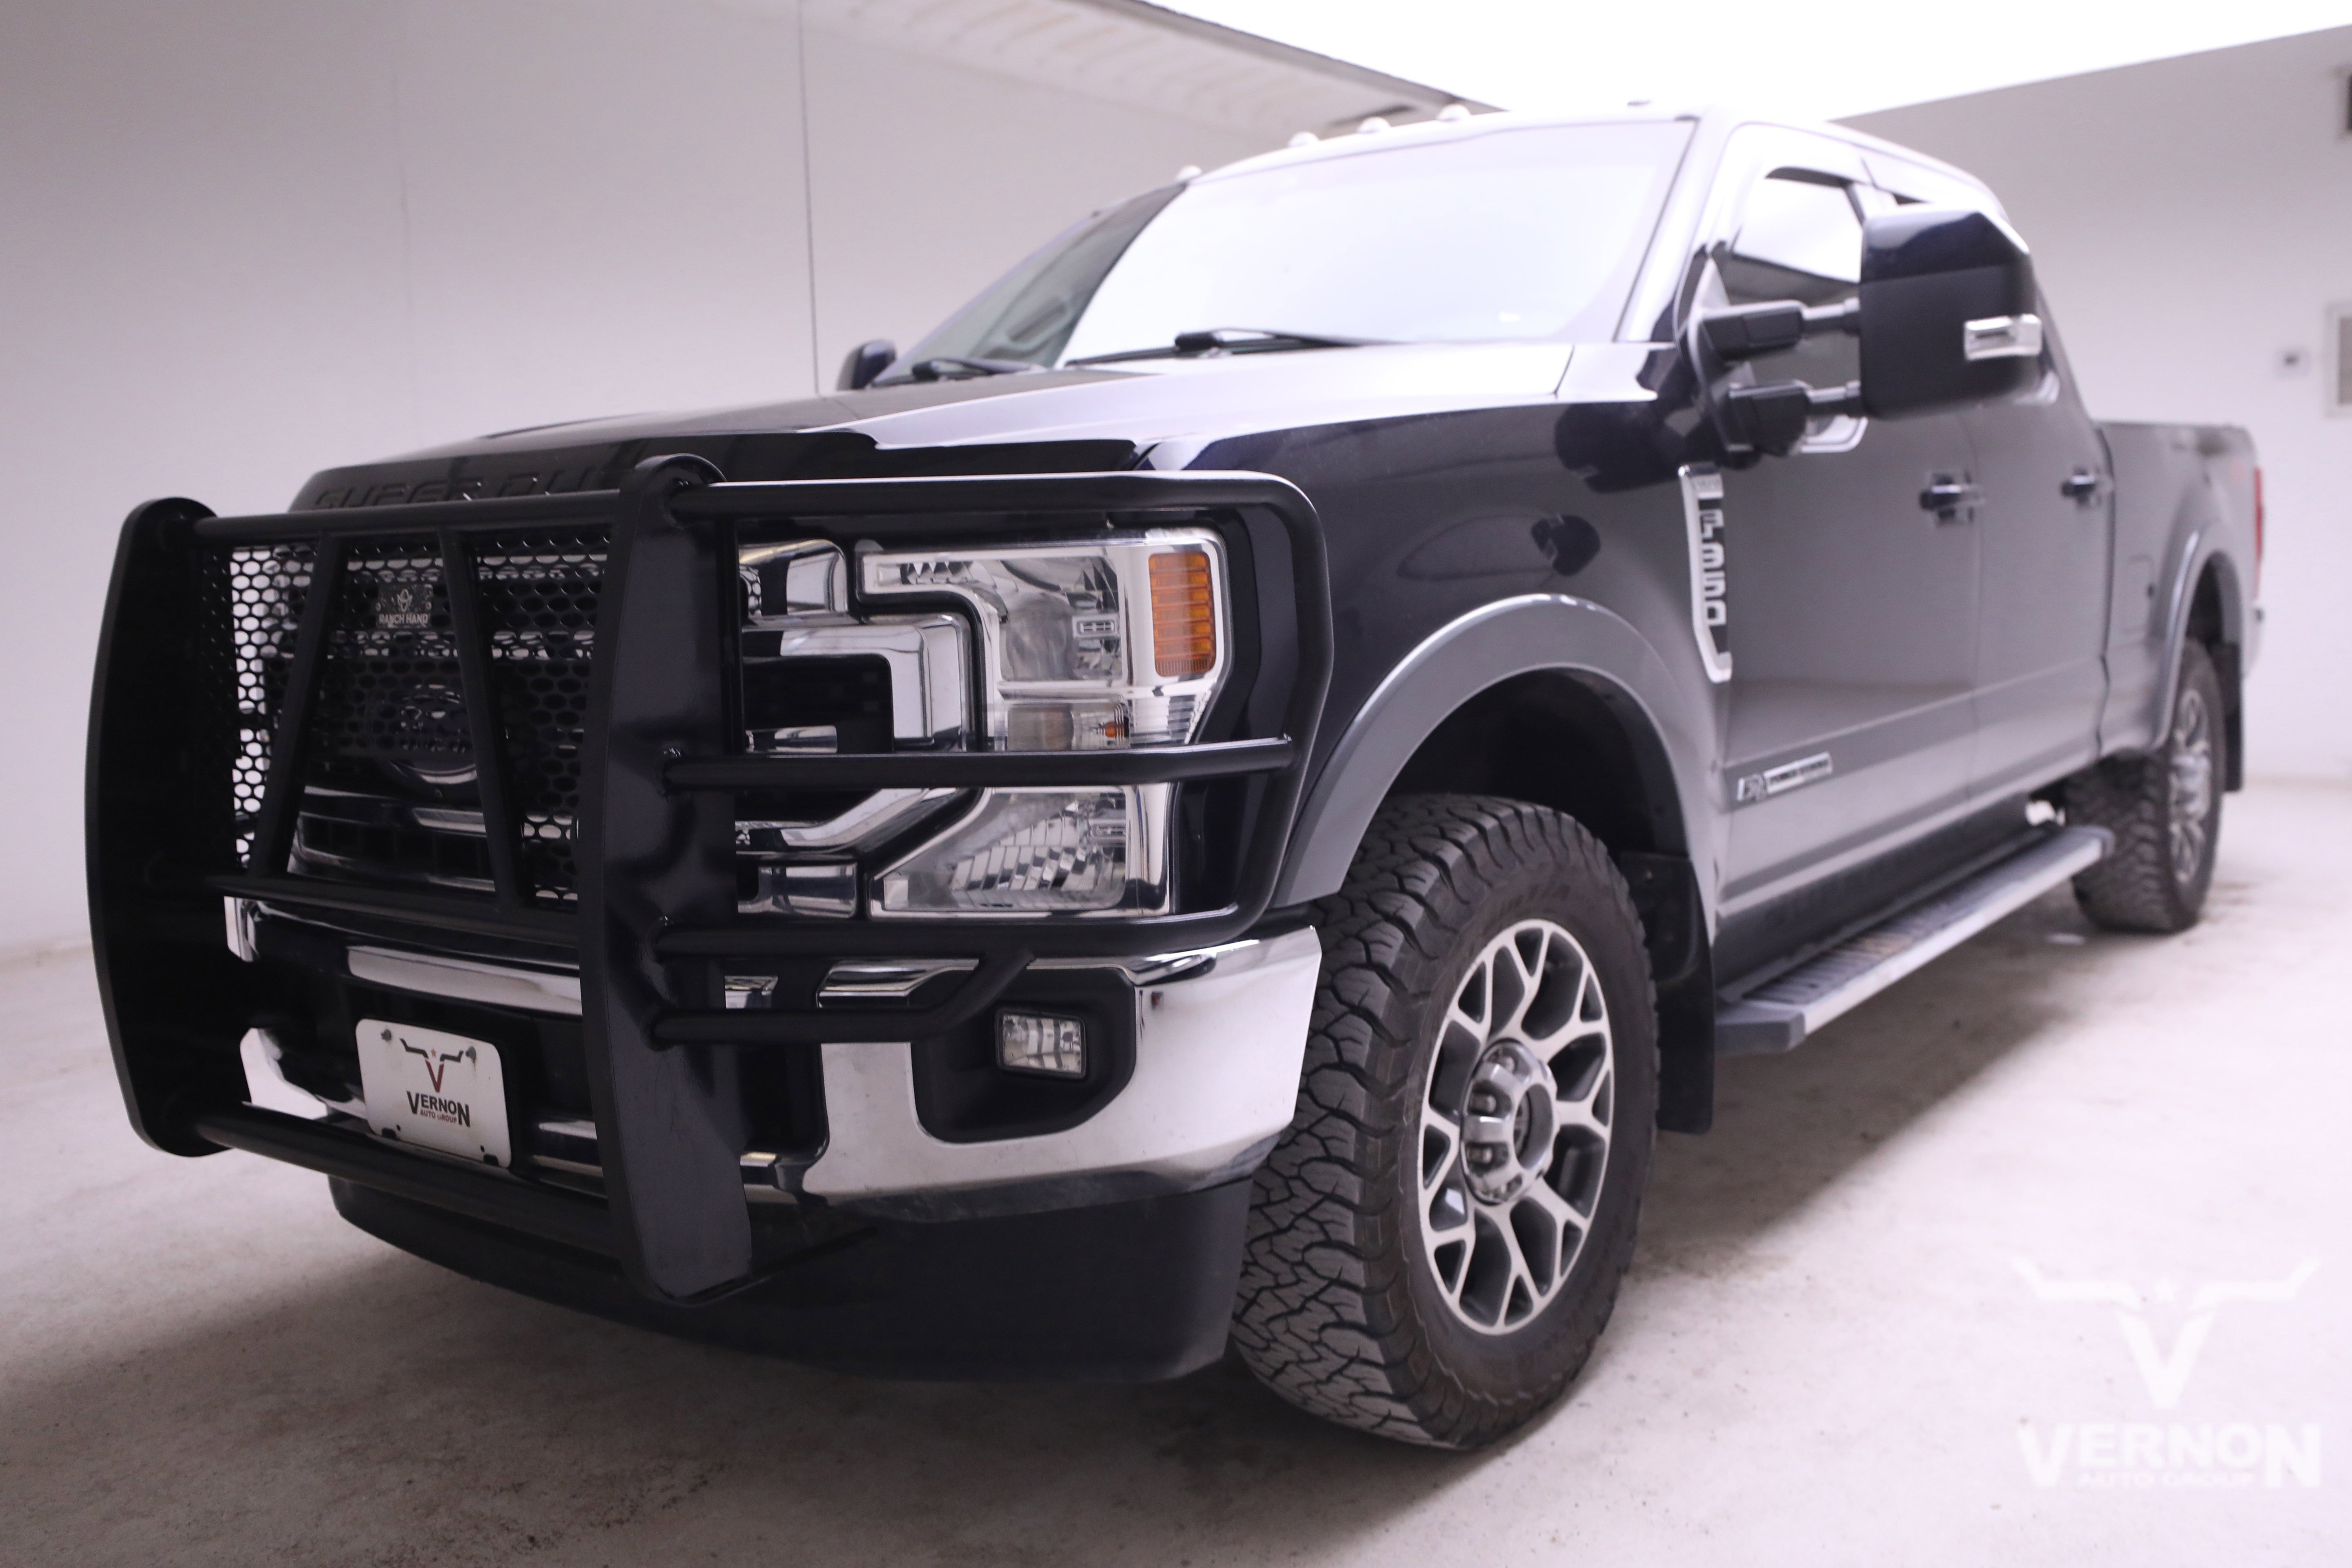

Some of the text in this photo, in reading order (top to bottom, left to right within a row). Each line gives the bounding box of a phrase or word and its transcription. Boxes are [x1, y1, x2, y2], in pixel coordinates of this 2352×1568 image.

[379, 613, 428, 625] RANCH HAND
[406, 1090, 471, 1128] VERNON
[420, 1109, 436, 1119] AUTO
